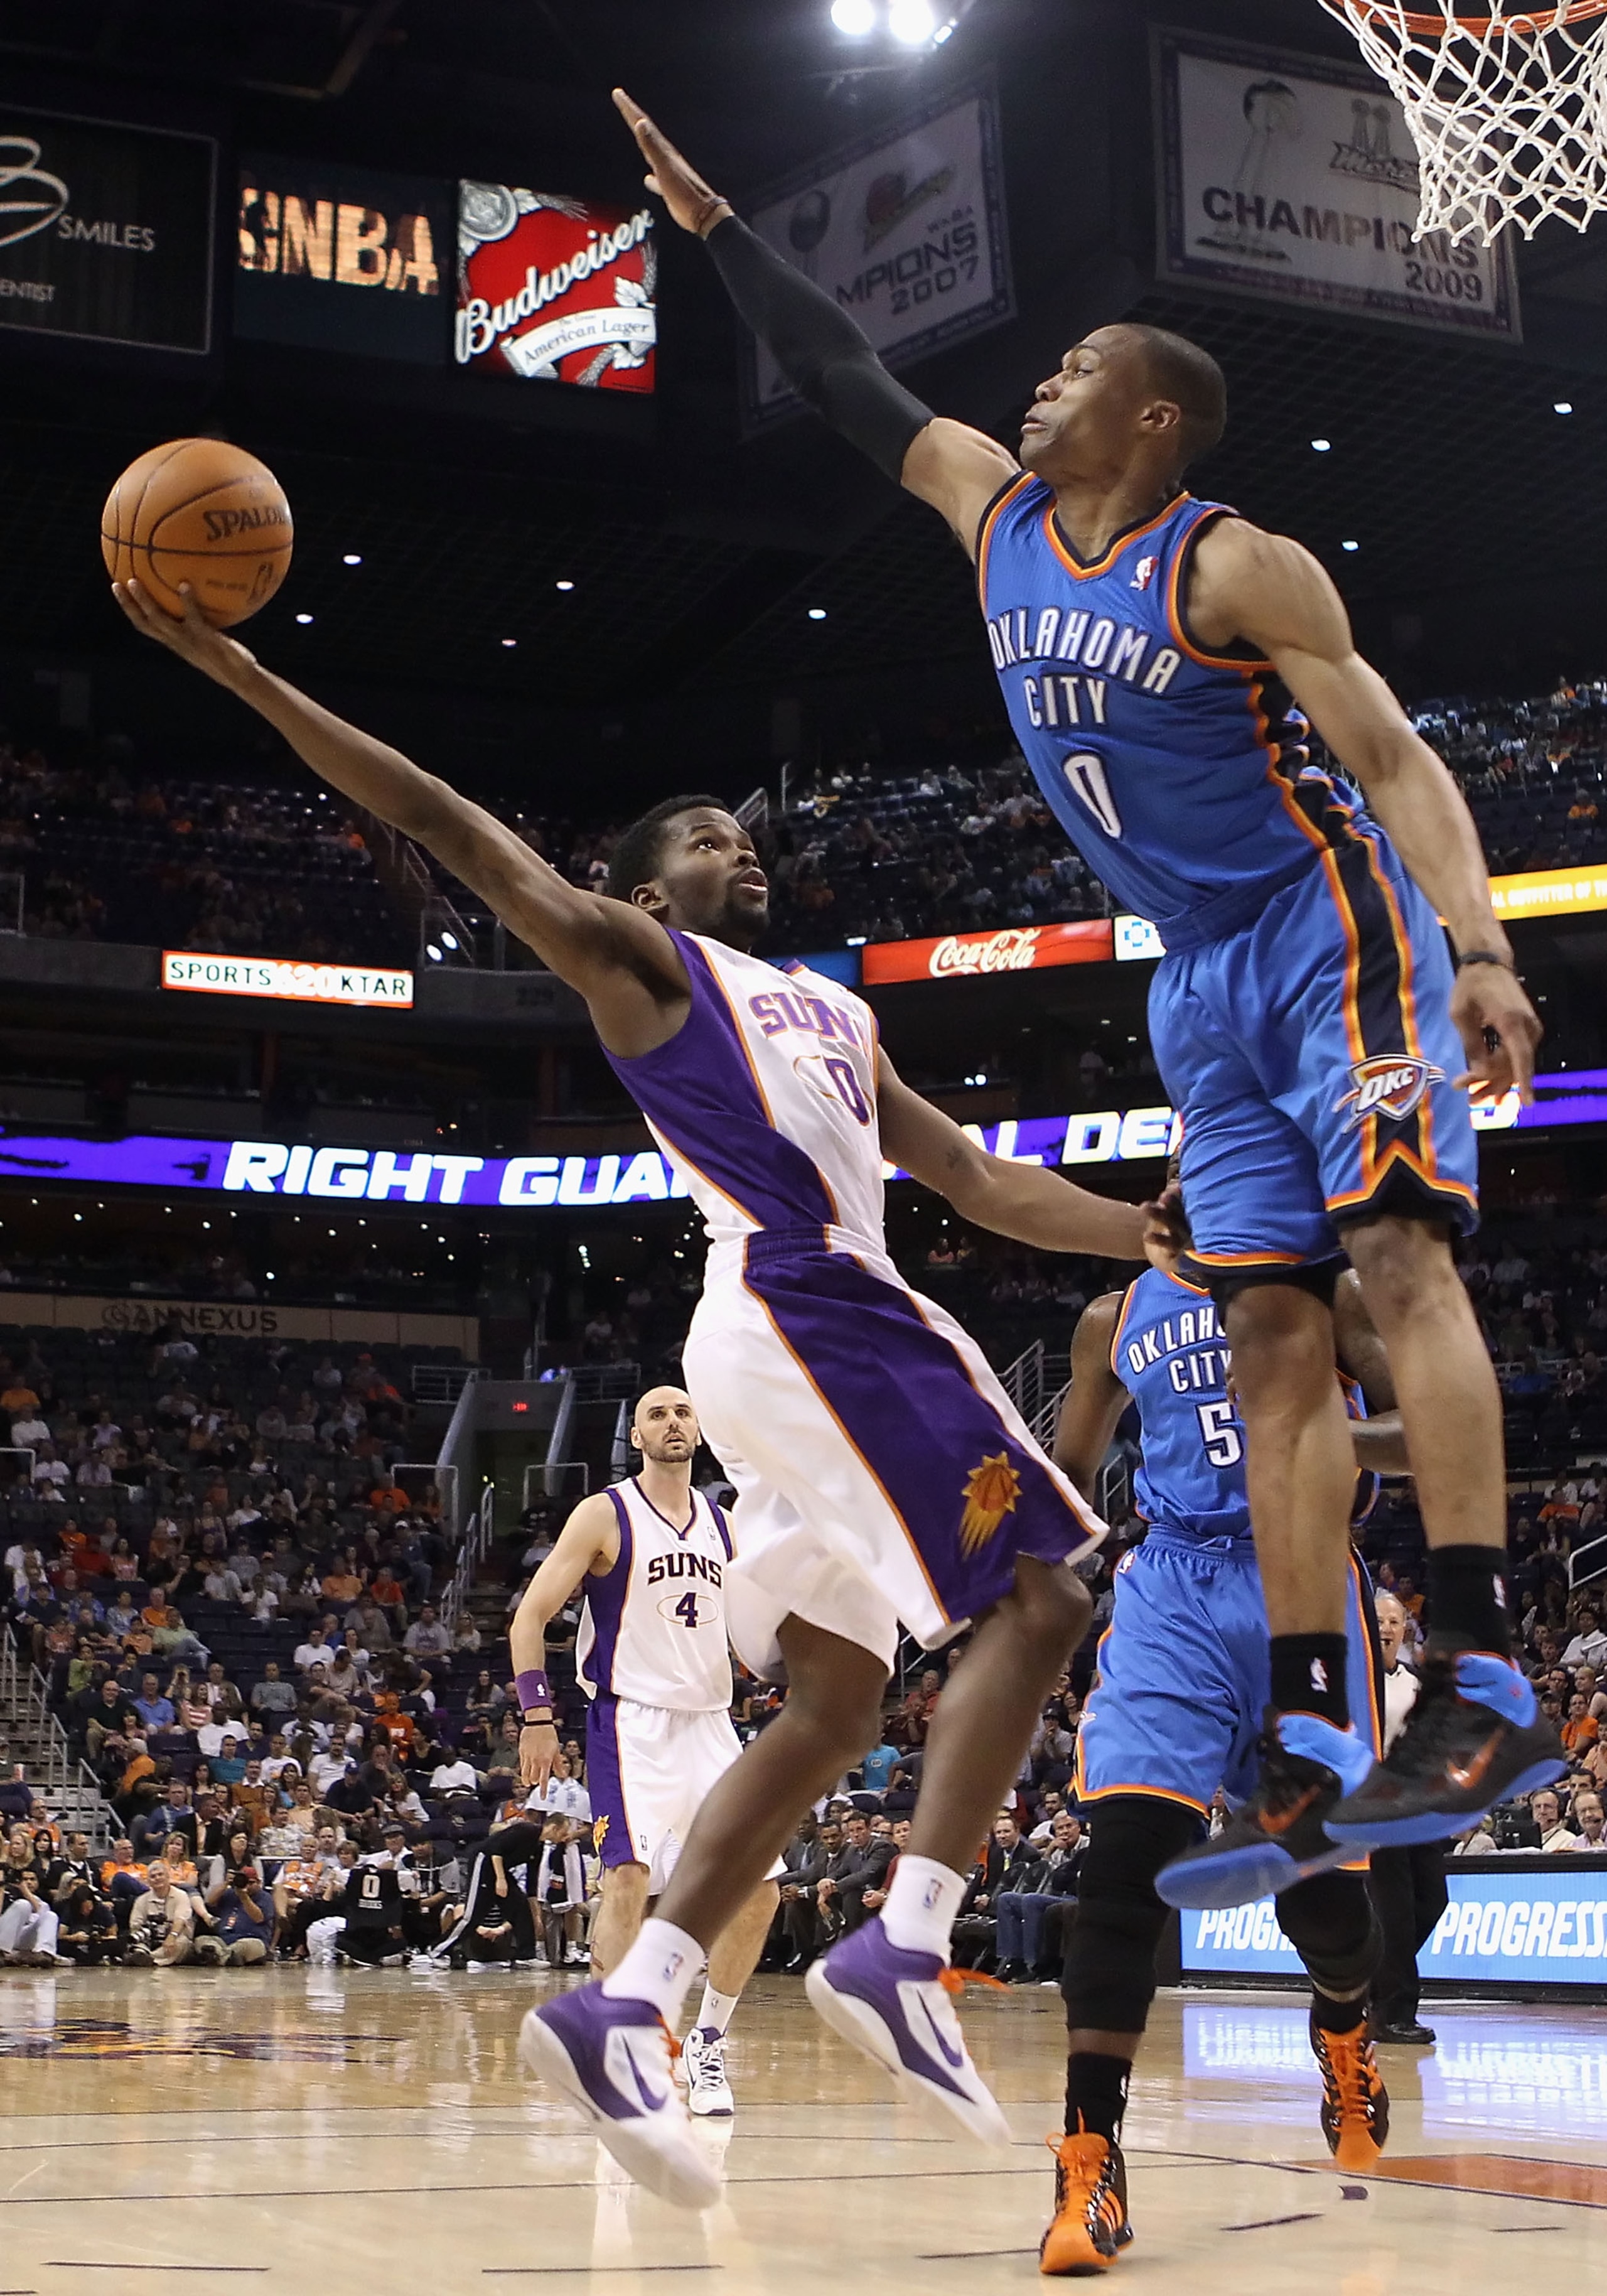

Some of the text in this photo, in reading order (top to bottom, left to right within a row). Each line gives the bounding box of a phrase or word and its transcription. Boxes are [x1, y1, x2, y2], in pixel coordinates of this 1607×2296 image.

[58, 215, 156, 251] SMILES
[1202, 187, 1480, 270] CHAMPIONS
[455, 208, 655, 364] Budweiser
[836, 220, 978, 305] MPIONS
[890, 254, 979, 315] 2007
[1405, 261, 1483, 302] 2009
[523, 320, 650, 366] American Lager
[203, 506, 287, 541] SPALD
[988, 607, 1181, 694] OKLAHOMA
[1023, 676, 1106, 728] CITY
[1063, 752, 1122, 839] 0
[170, 961, 271, 986] SPORTS
[341, 975, 406, 996] KTAR
[823, 1056, 869, 1126] 0
[222, 1140, 484, 1204] RIGHT
[1128, 1306, 1227, 1374] OKLAH
[1196, 1400, 1242, 1468] 5
[647, 1551, 722, 1589] SUNS
[675, 1591, 699, 1628] 4
